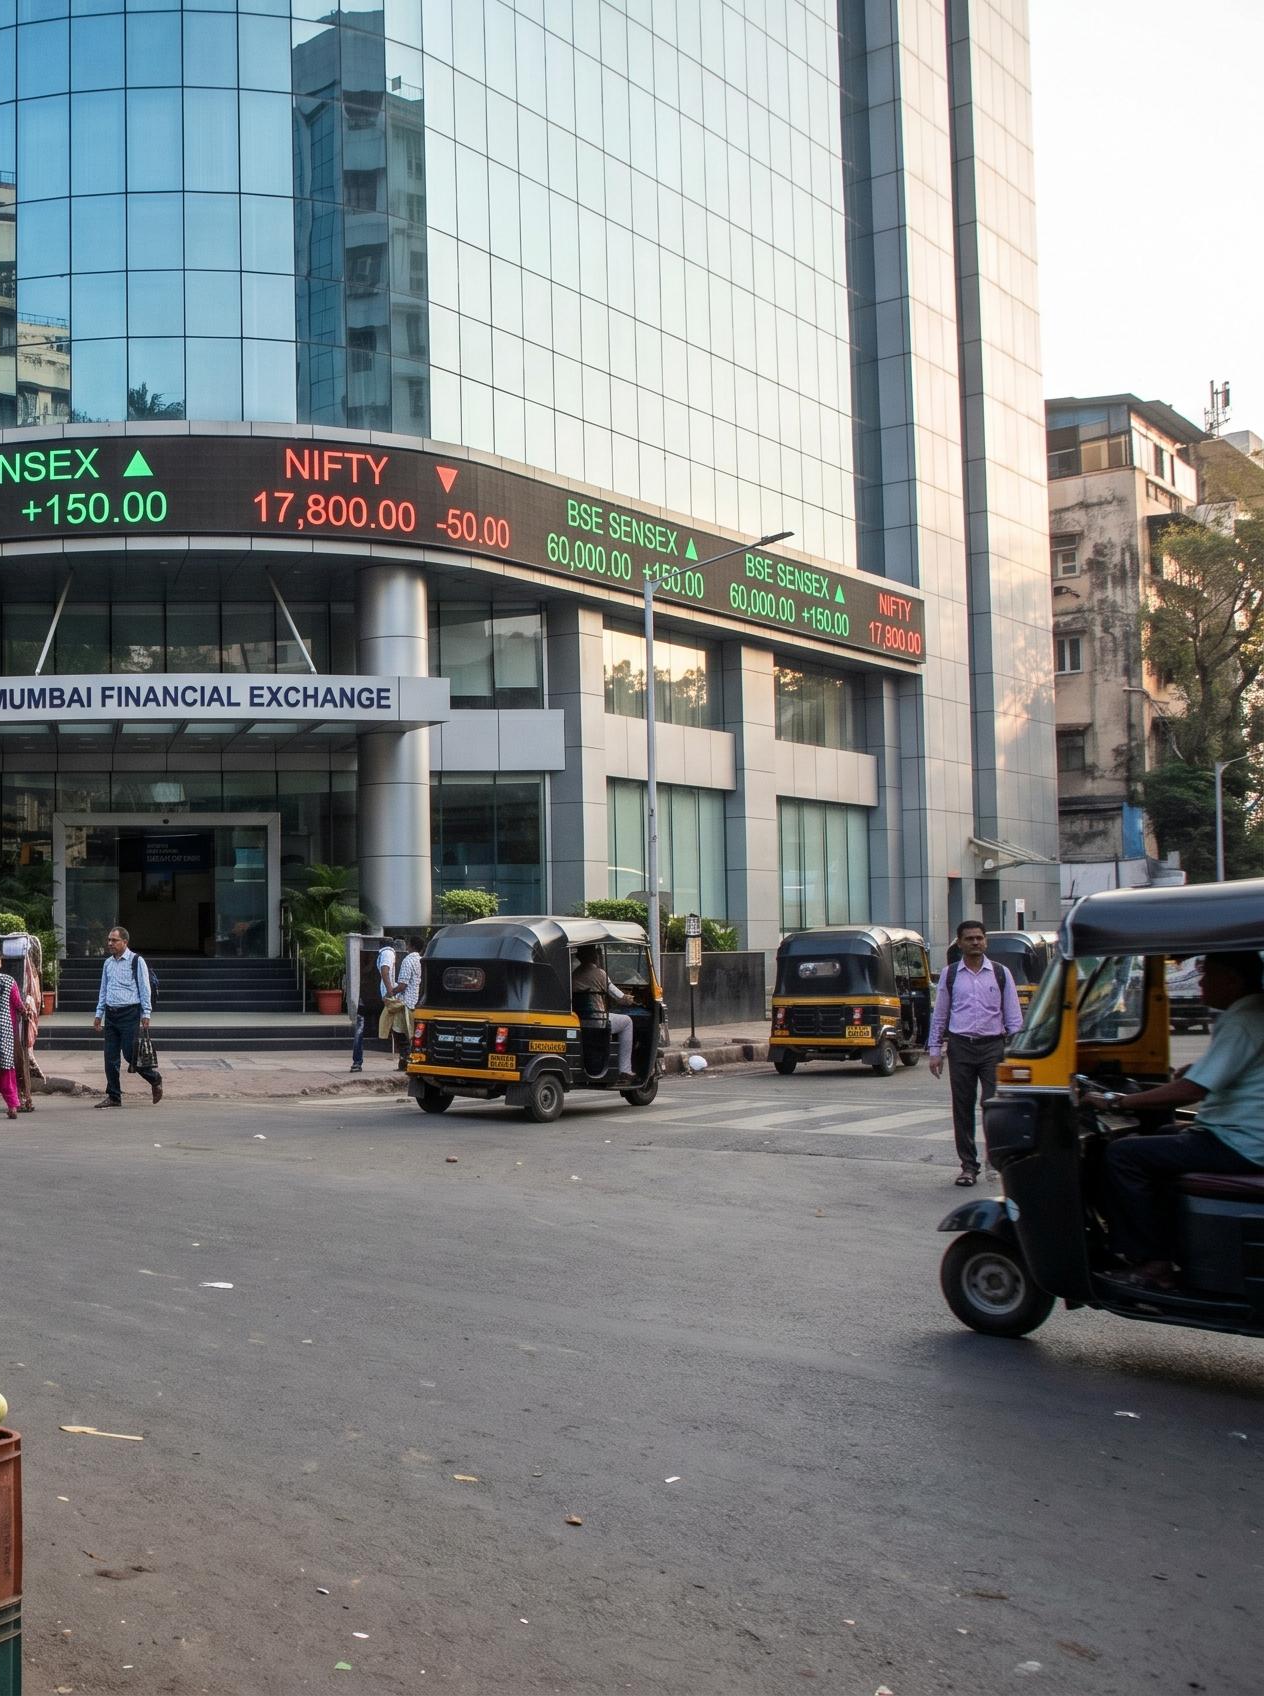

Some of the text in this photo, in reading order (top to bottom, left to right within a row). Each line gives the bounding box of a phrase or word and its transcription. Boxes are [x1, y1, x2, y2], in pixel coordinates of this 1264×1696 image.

[285, 448, 389, 485] NIFTY
[21, 490, 167, 525] +150.00
[253, 491, 510, 549] 17,800.00 -50.00
[567, 498, 679, 557] BSE SENSEX
[547, 532, 632, 581] 60,000.00
[745, 552, 830, 600] BSE SENSEX
[729, 582, 850, 637] 60,000.00 +150.00
[879, 592, 912, 622] NIFTY
[101, 685, 241, 708] FINANCIAL
[249, 686, 391, 709] EXCHANGE
